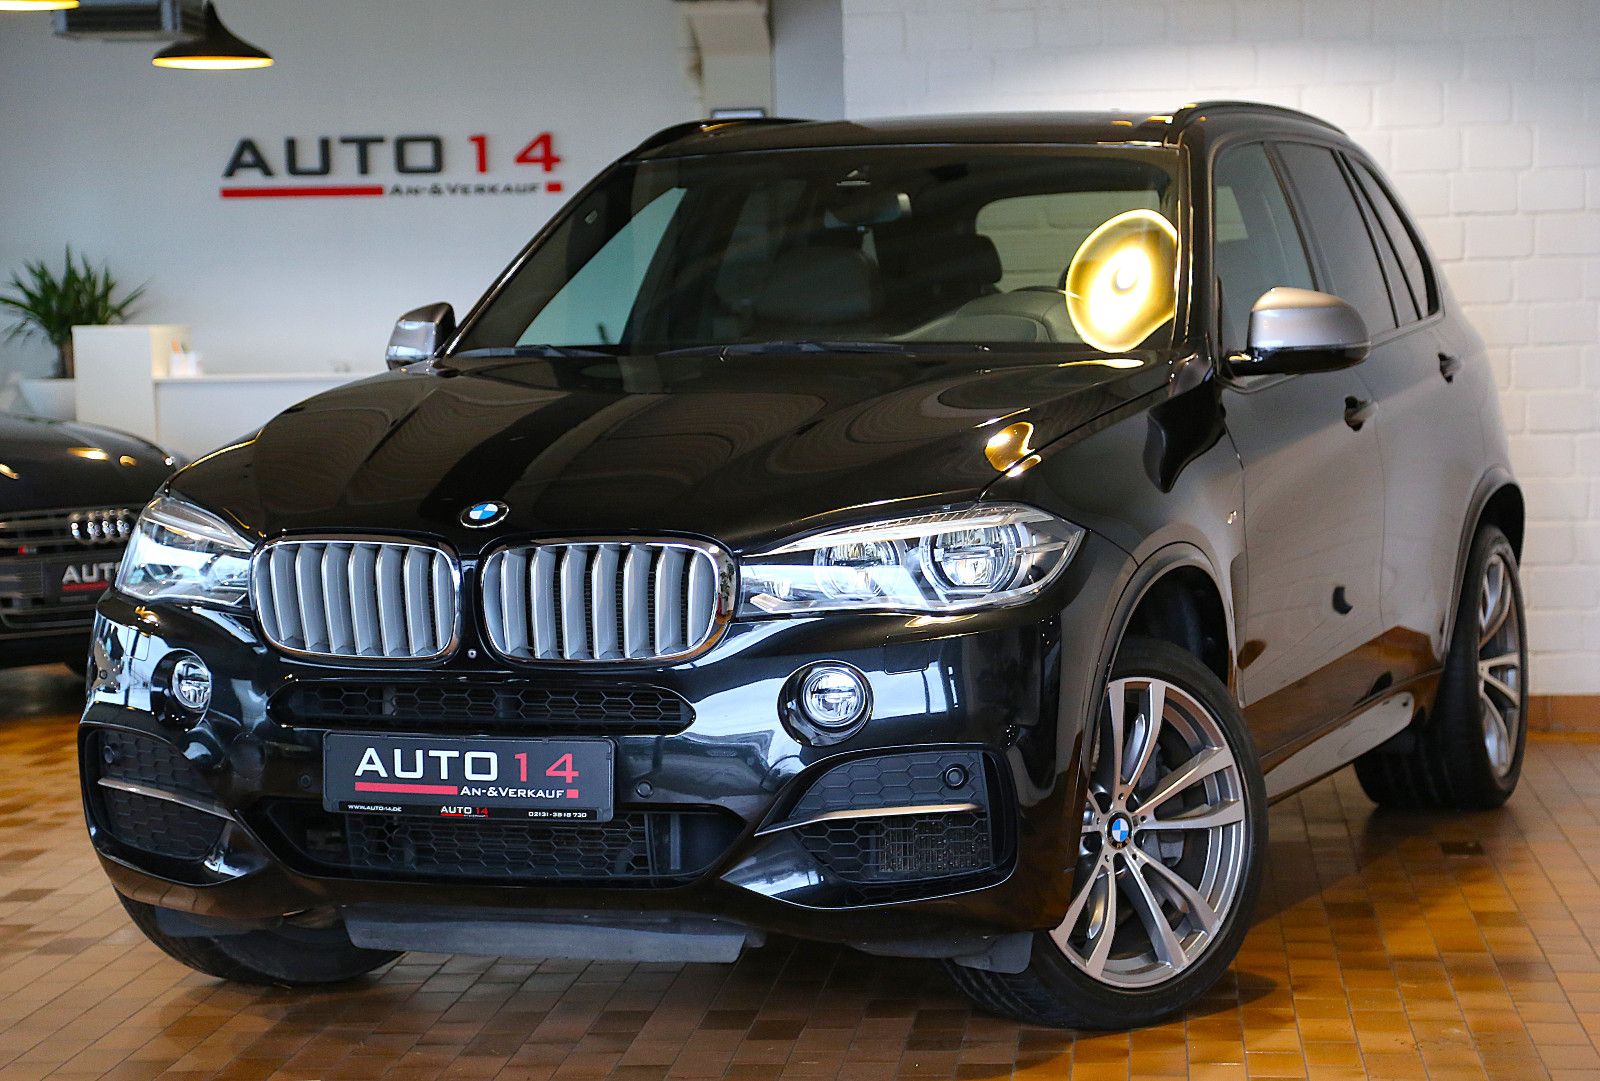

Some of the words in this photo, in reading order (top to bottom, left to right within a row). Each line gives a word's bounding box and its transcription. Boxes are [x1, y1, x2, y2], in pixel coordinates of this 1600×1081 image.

[222, 135, 444, 177] AUTO
[61, 562, 120, 584] AUT
[354, 746, 499, 782] AUTO
[440, 805, 473, 815] AUTO
